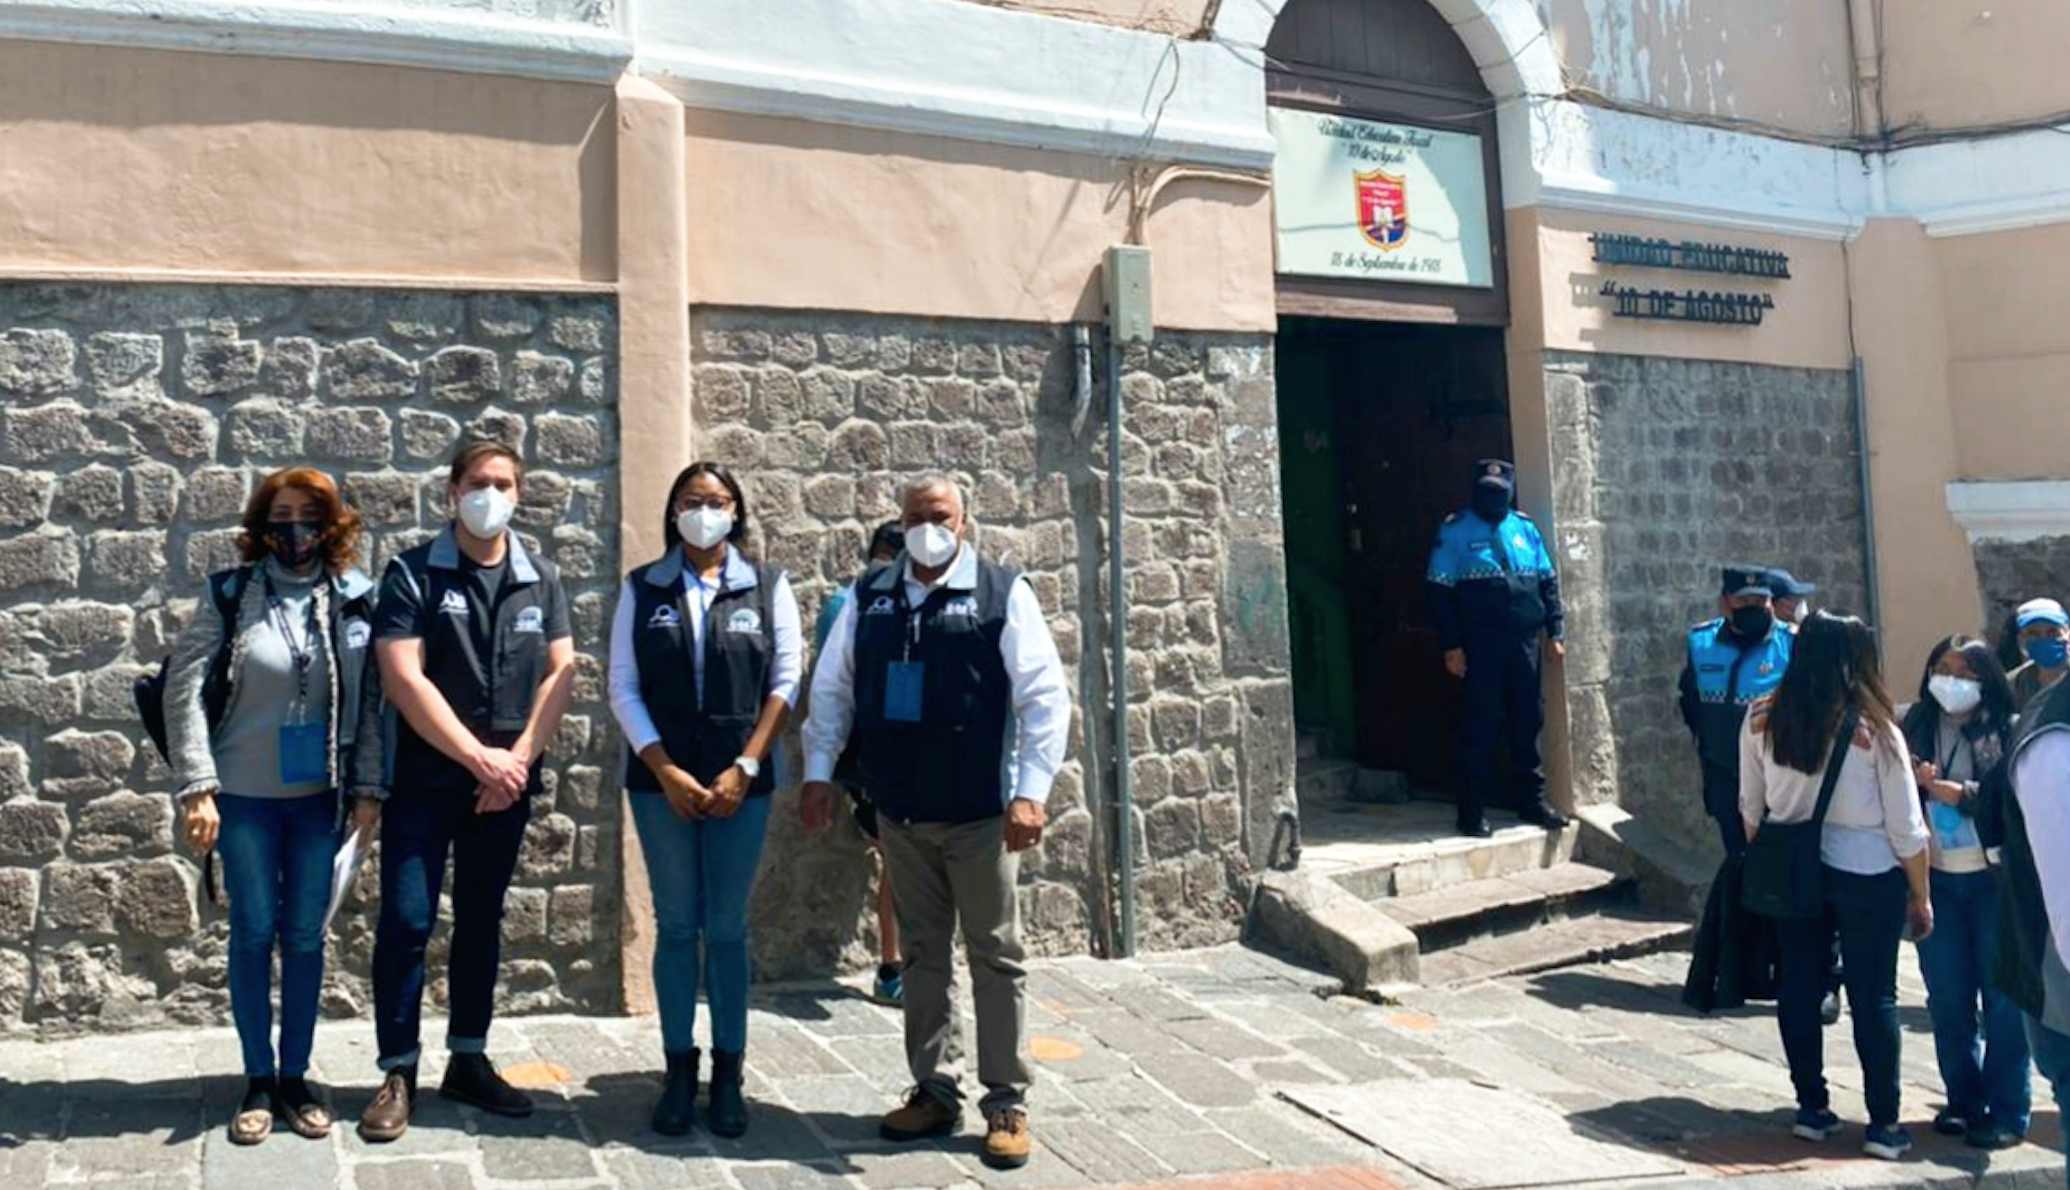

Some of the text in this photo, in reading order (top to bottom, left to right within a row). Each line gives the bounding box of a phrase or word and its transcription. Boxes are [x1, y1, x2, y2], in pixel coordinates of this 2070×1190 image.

[1345, 252, 1355, 268] de
[1408, 256, 1417, 272] de
[1594, 232, 1788, 279] UNIDAD EDUCATIVA
[1650, 290, 1675, 319] DE
